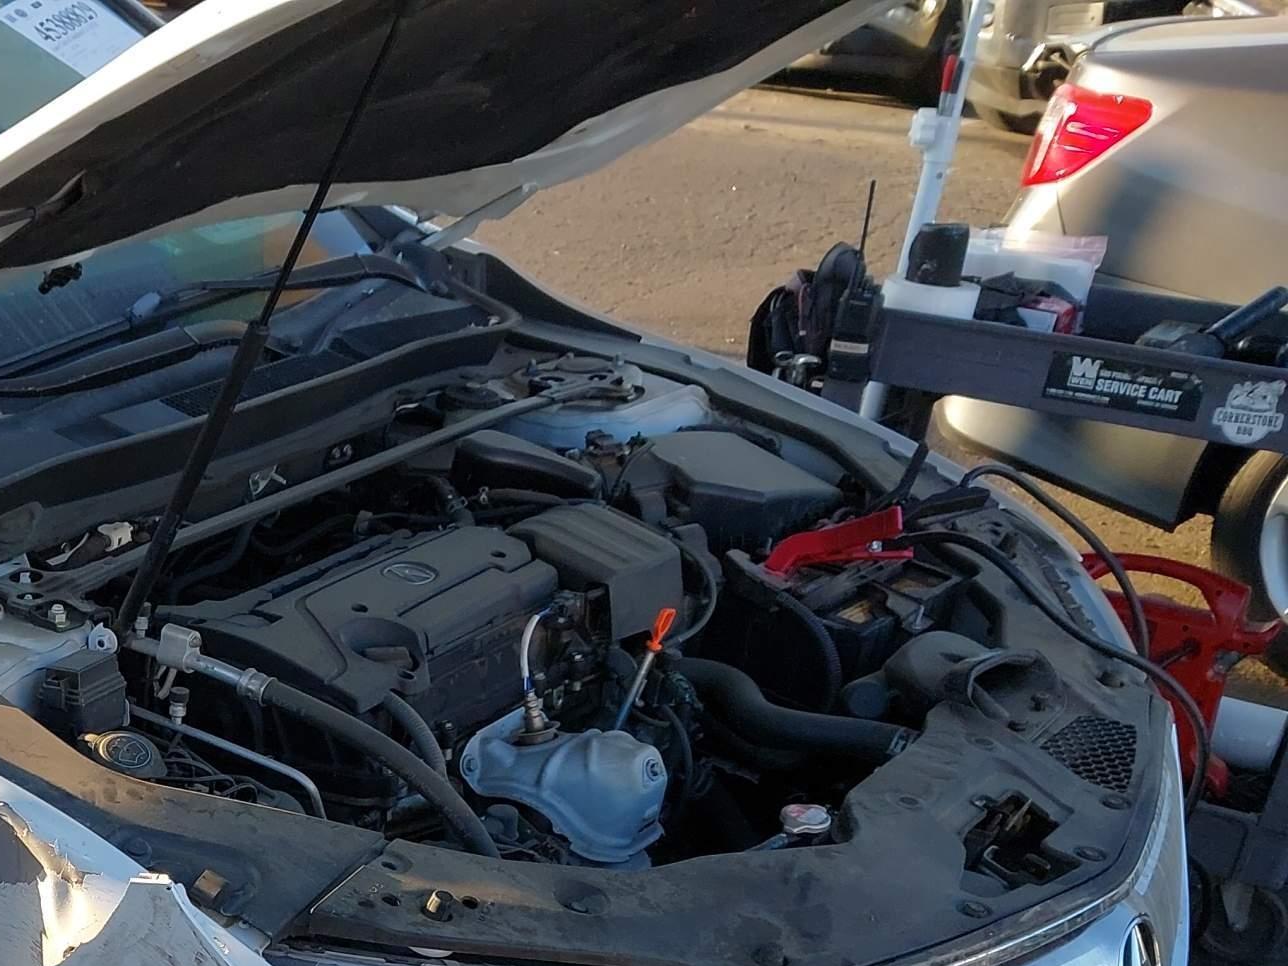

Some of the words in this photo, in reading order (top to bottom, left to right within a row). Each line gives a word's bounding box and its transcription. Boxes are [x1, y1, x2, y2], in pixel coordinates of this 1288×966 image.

[1095, 378, 1148, 398] SERVICE
[1148, 387, 1183, 403] CART
[1216, 409, 1279, 428] CORNERSTONE
